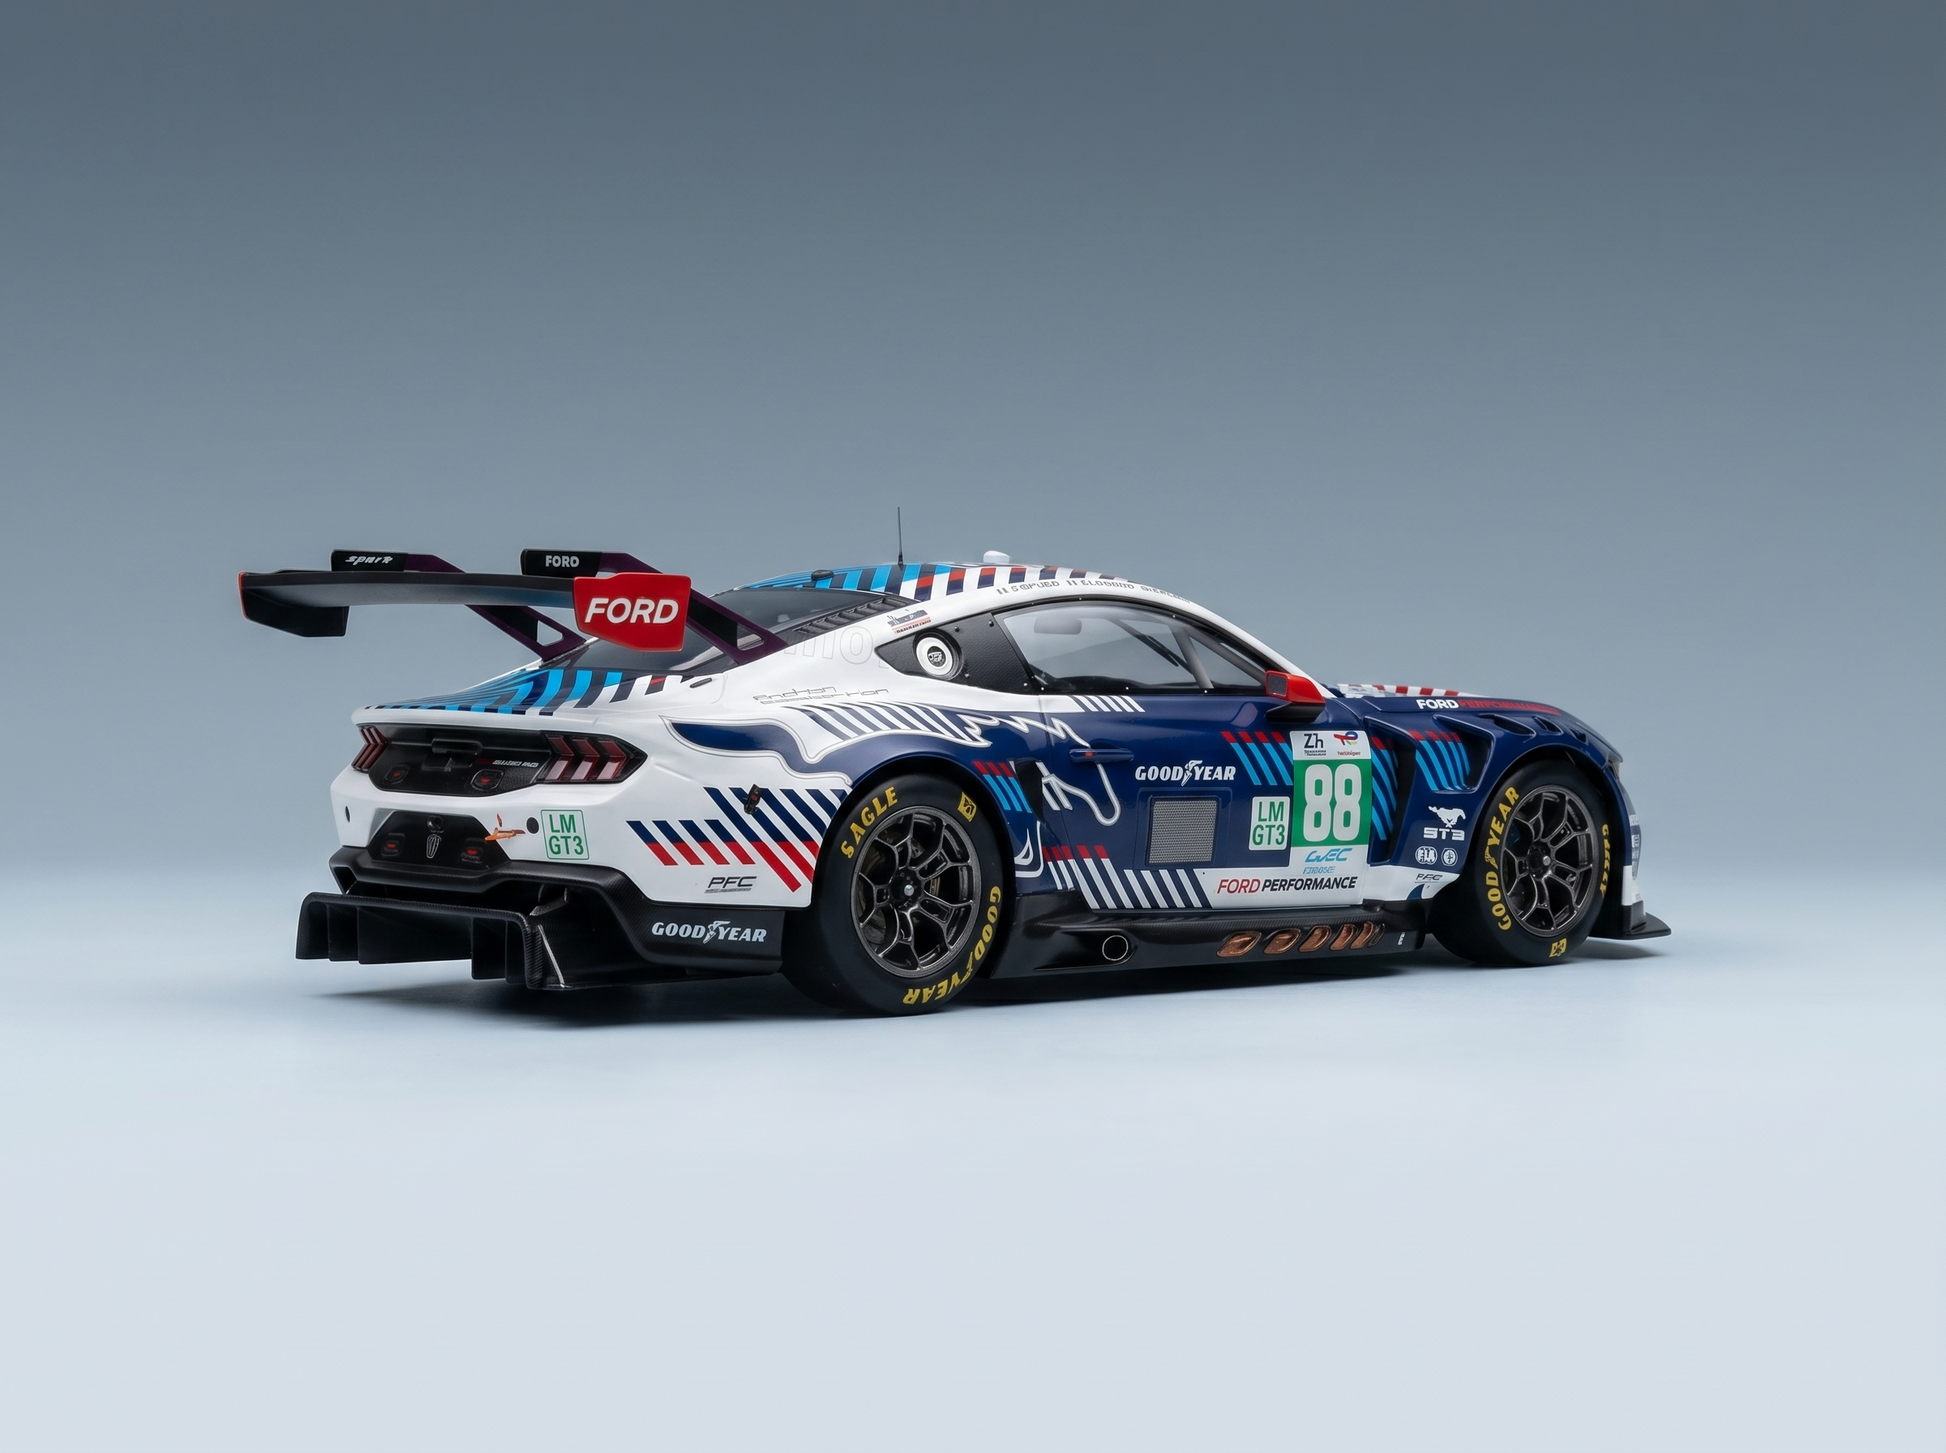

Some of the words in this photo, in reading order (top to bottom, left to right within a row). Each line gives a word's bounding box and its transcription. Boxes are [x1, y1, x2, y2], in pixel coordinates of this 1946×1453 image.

[545, 555, 579, 568] FORD
[584, 597, 679, 625] FORD
[1415, 699, 1459, 709] FORD
[1257, 801, 1285, 822] LM
[1303, 763, 1362, 842] 88
[549, 813, 577, 834] LM
[549, 835, 584, 856] GT3
[1252, 824, 1286, 846] GT3
[707, 876, 758, 889] PFC
[1217, 878, 1260, 895] FORD
[1261, 876, 1358, 892] PERFORMANCE
